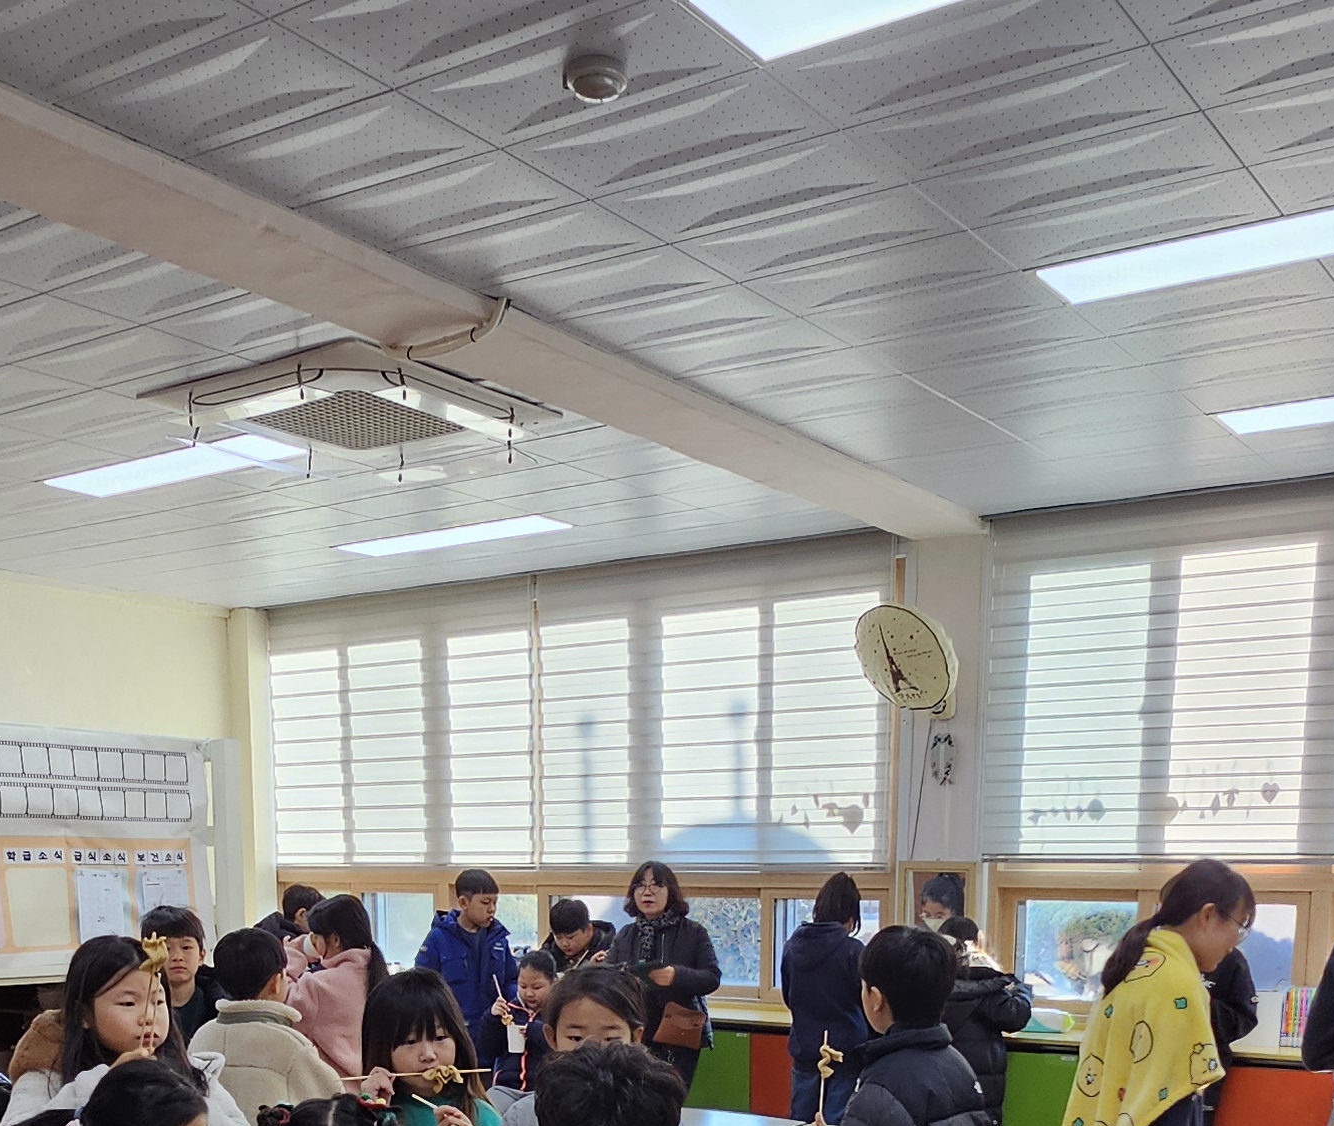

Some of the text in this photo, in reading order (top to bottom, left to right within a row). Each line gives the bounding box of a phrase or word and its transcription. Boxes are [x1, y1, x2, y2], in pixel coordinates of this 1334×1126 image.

[5, 849, 64, 861] 학급소식
[73, 850, 127, 863] 급식소식
[137, 851, 184, 863] 보건소식
